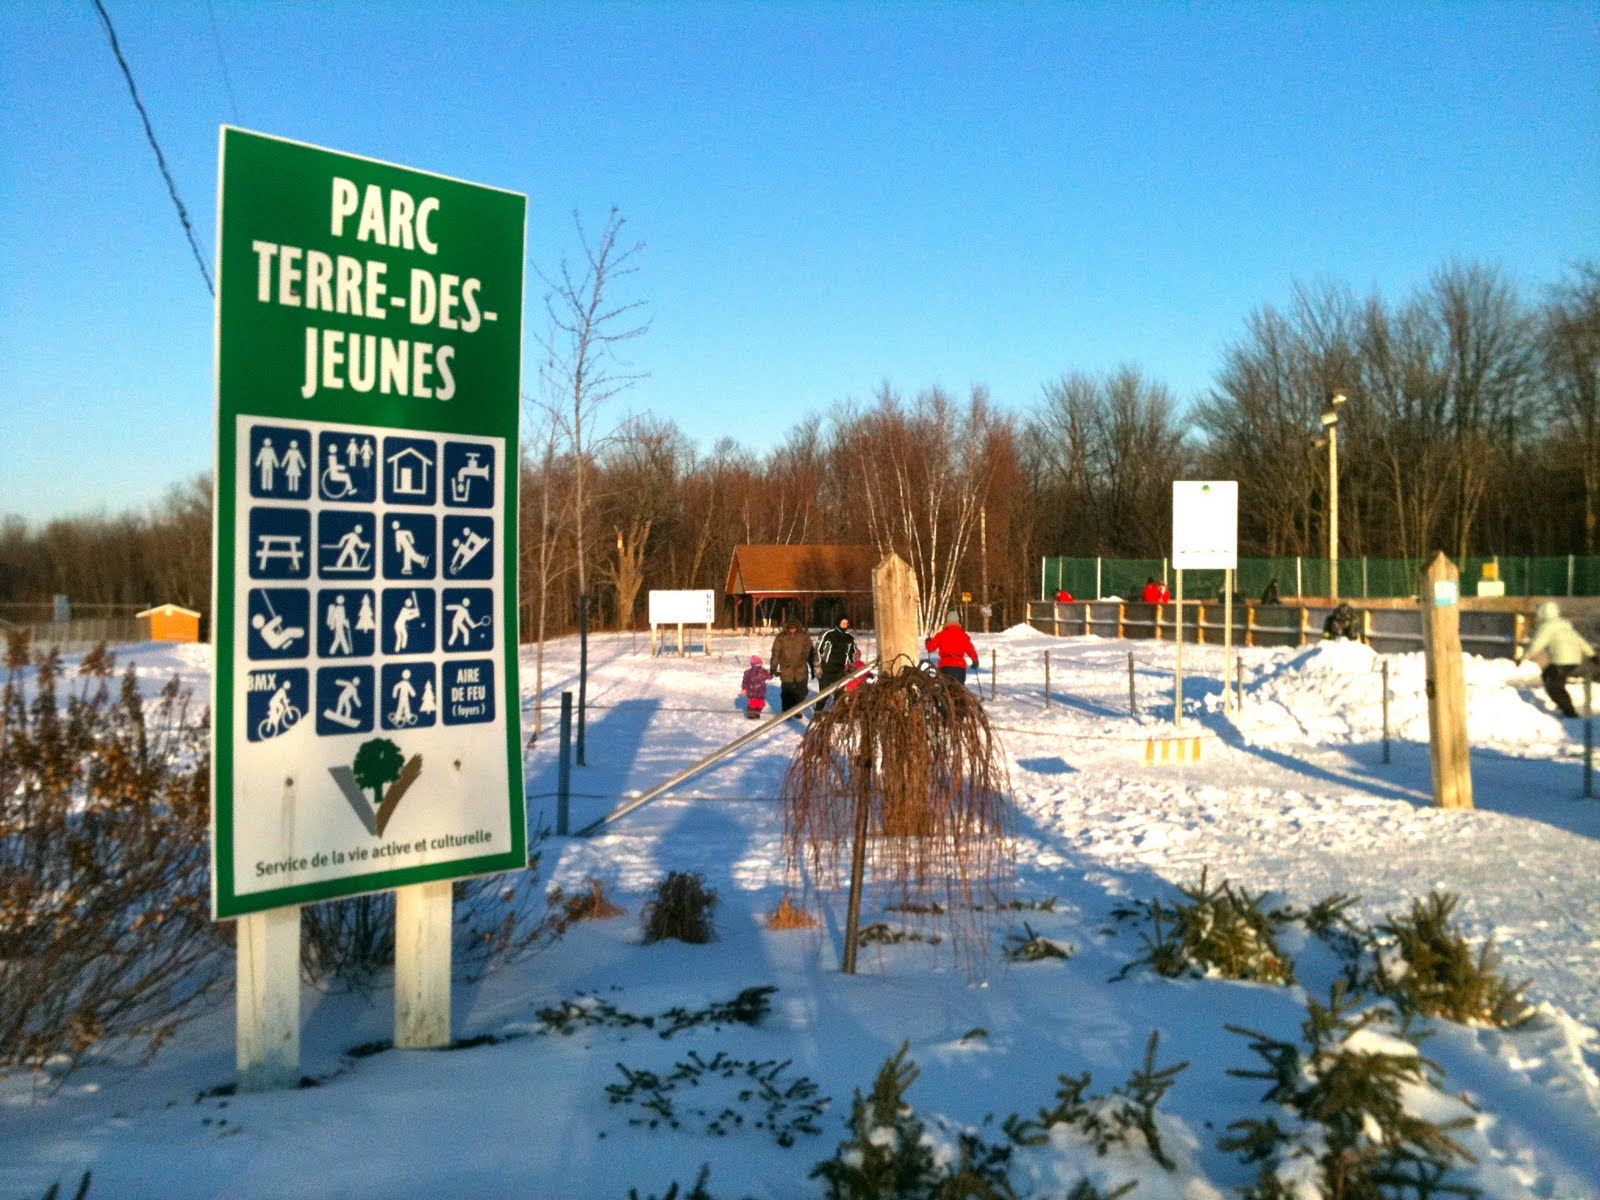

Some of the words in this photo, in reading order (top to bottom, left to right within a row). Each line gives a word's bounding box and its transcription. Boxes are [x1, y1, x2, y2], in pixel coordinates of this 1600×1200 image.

[331, 176, 440, 255] PARC
[252, 240, 498, 333] TERRE-DES-
[301, 327, 456, 401] JEUNES
[246, 673, 277, 691] BMX
[451, 687, 465, 702] DE
[467, 685, 486, 701] FEU
[456, 667, 480, 684] AIRE
[255, 856, 307, 877] Service
[311, 851, 329, 868] de
[332, 849, 345, 865] la
[348, 846, 369, 861] vie
[372, 840, 412, 858] active
[414, 838, 427, 852] et
[430, 828, 493, 849] culturelle
